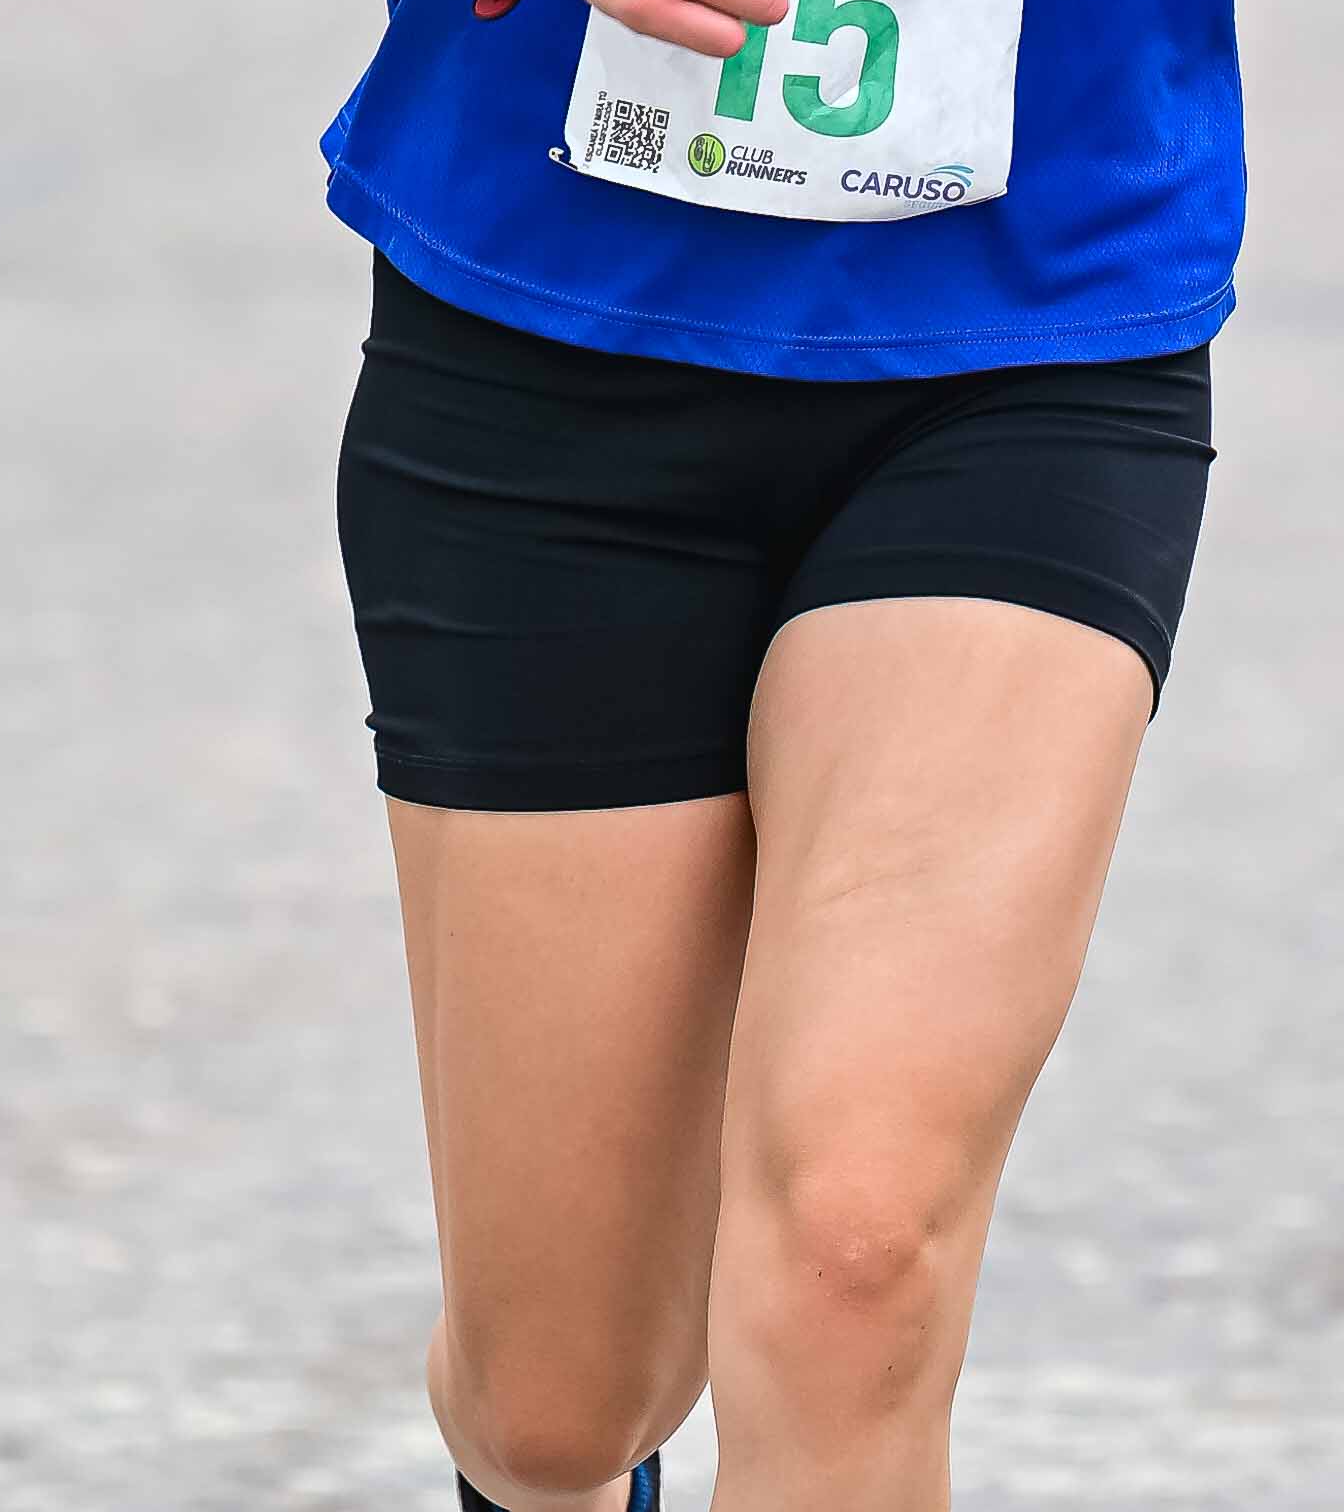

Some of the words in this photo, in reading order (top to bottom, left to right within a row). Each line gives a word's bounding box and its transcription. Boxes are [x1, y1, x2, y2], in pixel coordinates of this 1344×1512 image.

[730, 145, 774, 164] CLUB
[725, 160, 807, 185] RUNNER'S
[841, 169, 965, 202] CARUSO
